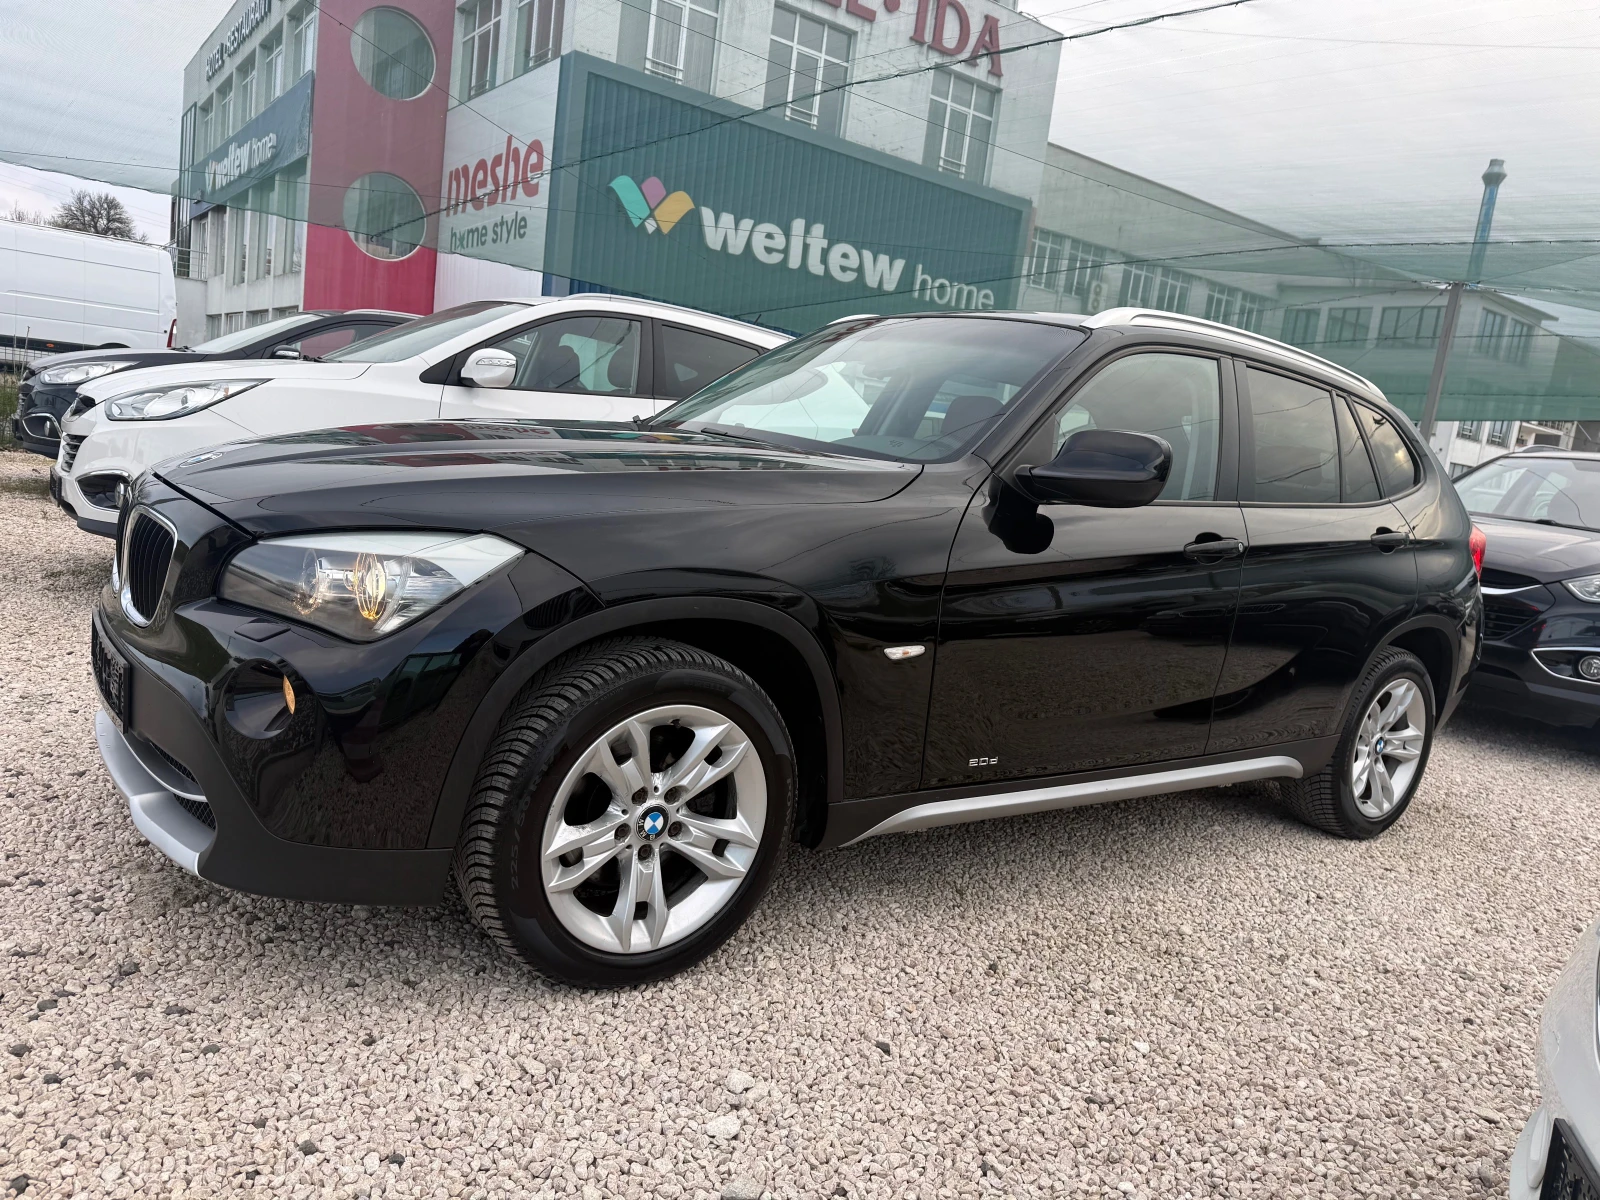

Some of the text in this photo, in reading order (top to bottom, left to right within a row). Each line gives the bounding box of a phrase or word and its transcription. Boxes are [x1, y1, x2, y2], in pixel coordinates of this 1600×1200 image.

[205, 43, 225, 82] HOTEL
[215, 132, 277, 190] weltew home
[445, 134, 545, 218] meshe
[491, 211, 528, 244] style
[700, 206, 995, 310] weltew home
[968, 756, 998, 767] 20d
